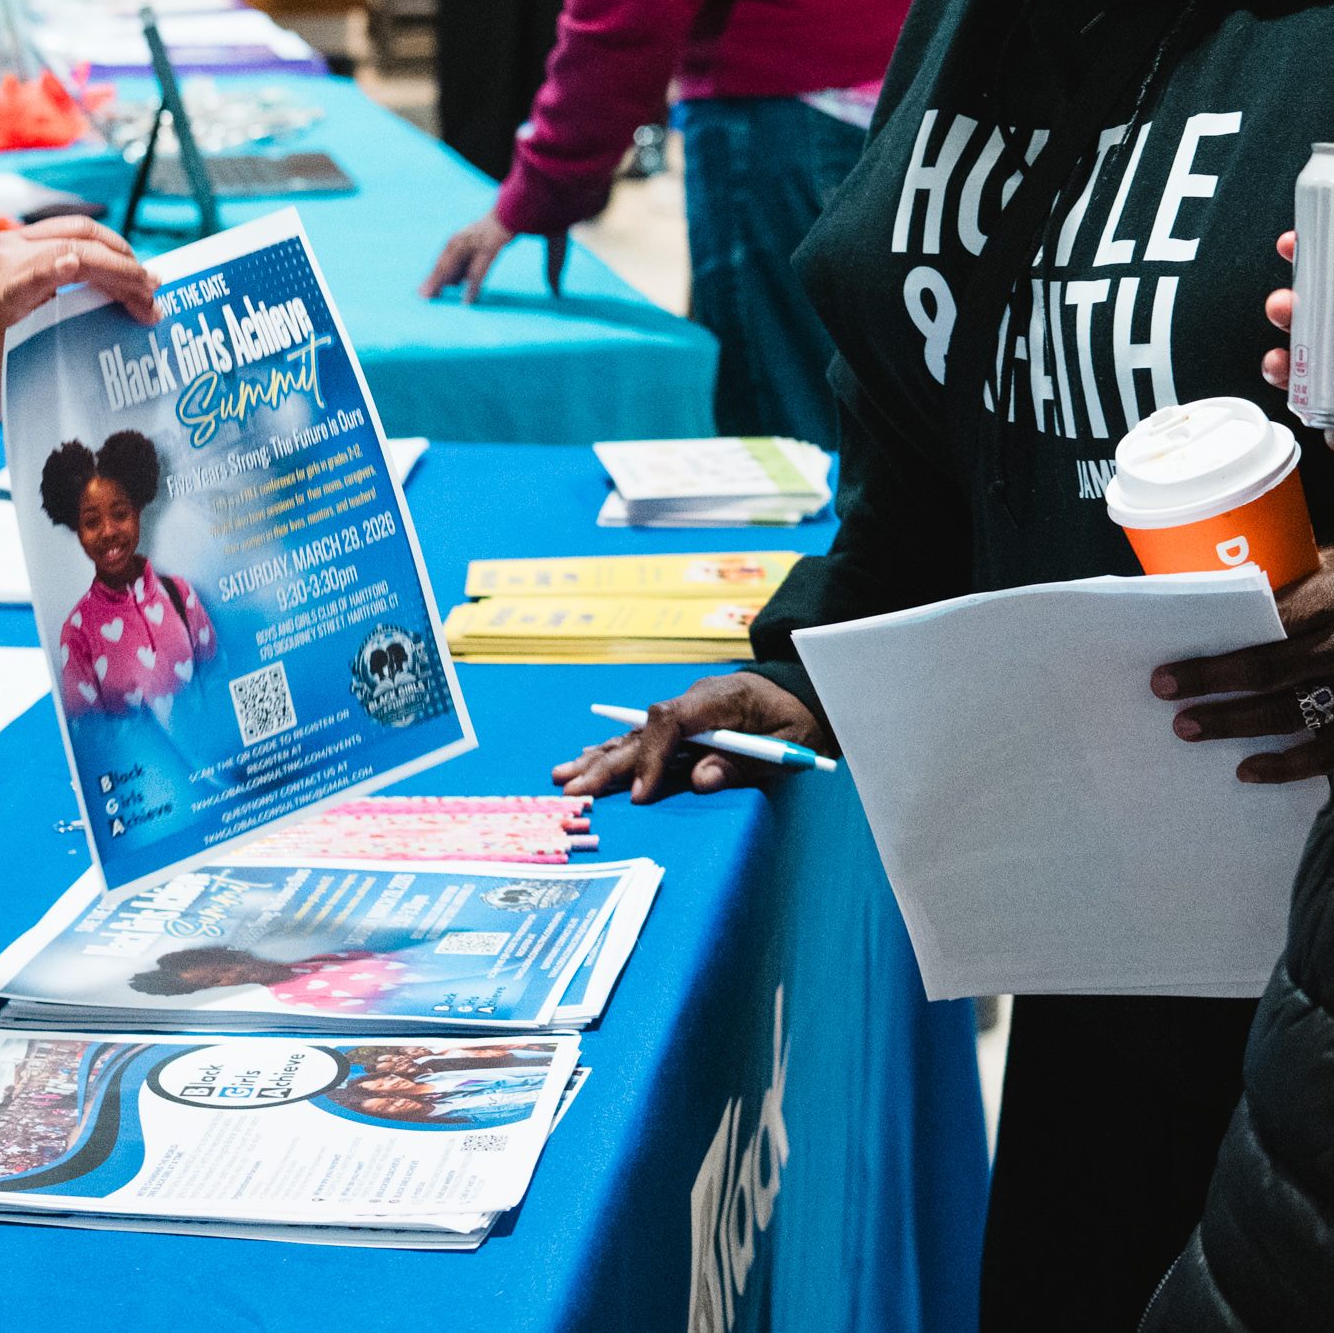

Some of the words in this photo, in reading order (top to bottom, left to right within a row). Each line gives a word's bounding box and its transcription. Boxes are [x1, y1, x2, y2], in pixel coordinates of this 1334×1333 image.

[891, 109, 1242, 266] HUTLE
[158, 292, 180, 318] AVE
[178, 283, 203, 311] THE
[200, 274, 229, 302] DATE
[99, 332, 177, 411] Black
[171, 312, 232, 386] Girls
[222, 295, 314, 367] Achieve
[178, 333, 331, 447] Summit
[167, 474, 194, 499] Five
[194, 462, 228, 488] Years
[269, 435, 294, 458] The
[292, 422, 329, 451] Future
[337, 407, 365, 432] Ours
[218, 554, 292, 602] SATURDAY,
[291, 536, 342, 572] MARCH
[276, 562, 358, 611] 9:30-3:30pm
[278, 620, 294, 637] AND
[317, 602, 338, 621] CLUB
[349, 581, 389, 607] HARTFORD
[388, 594, 399, 608] CT
[280, 773, 321, 797] CONTACT
[186, 1064, 224, 1097] Black
[224, 1070, 261, 1098] Girls
[264, 1053, 306, 1098] Achieve
